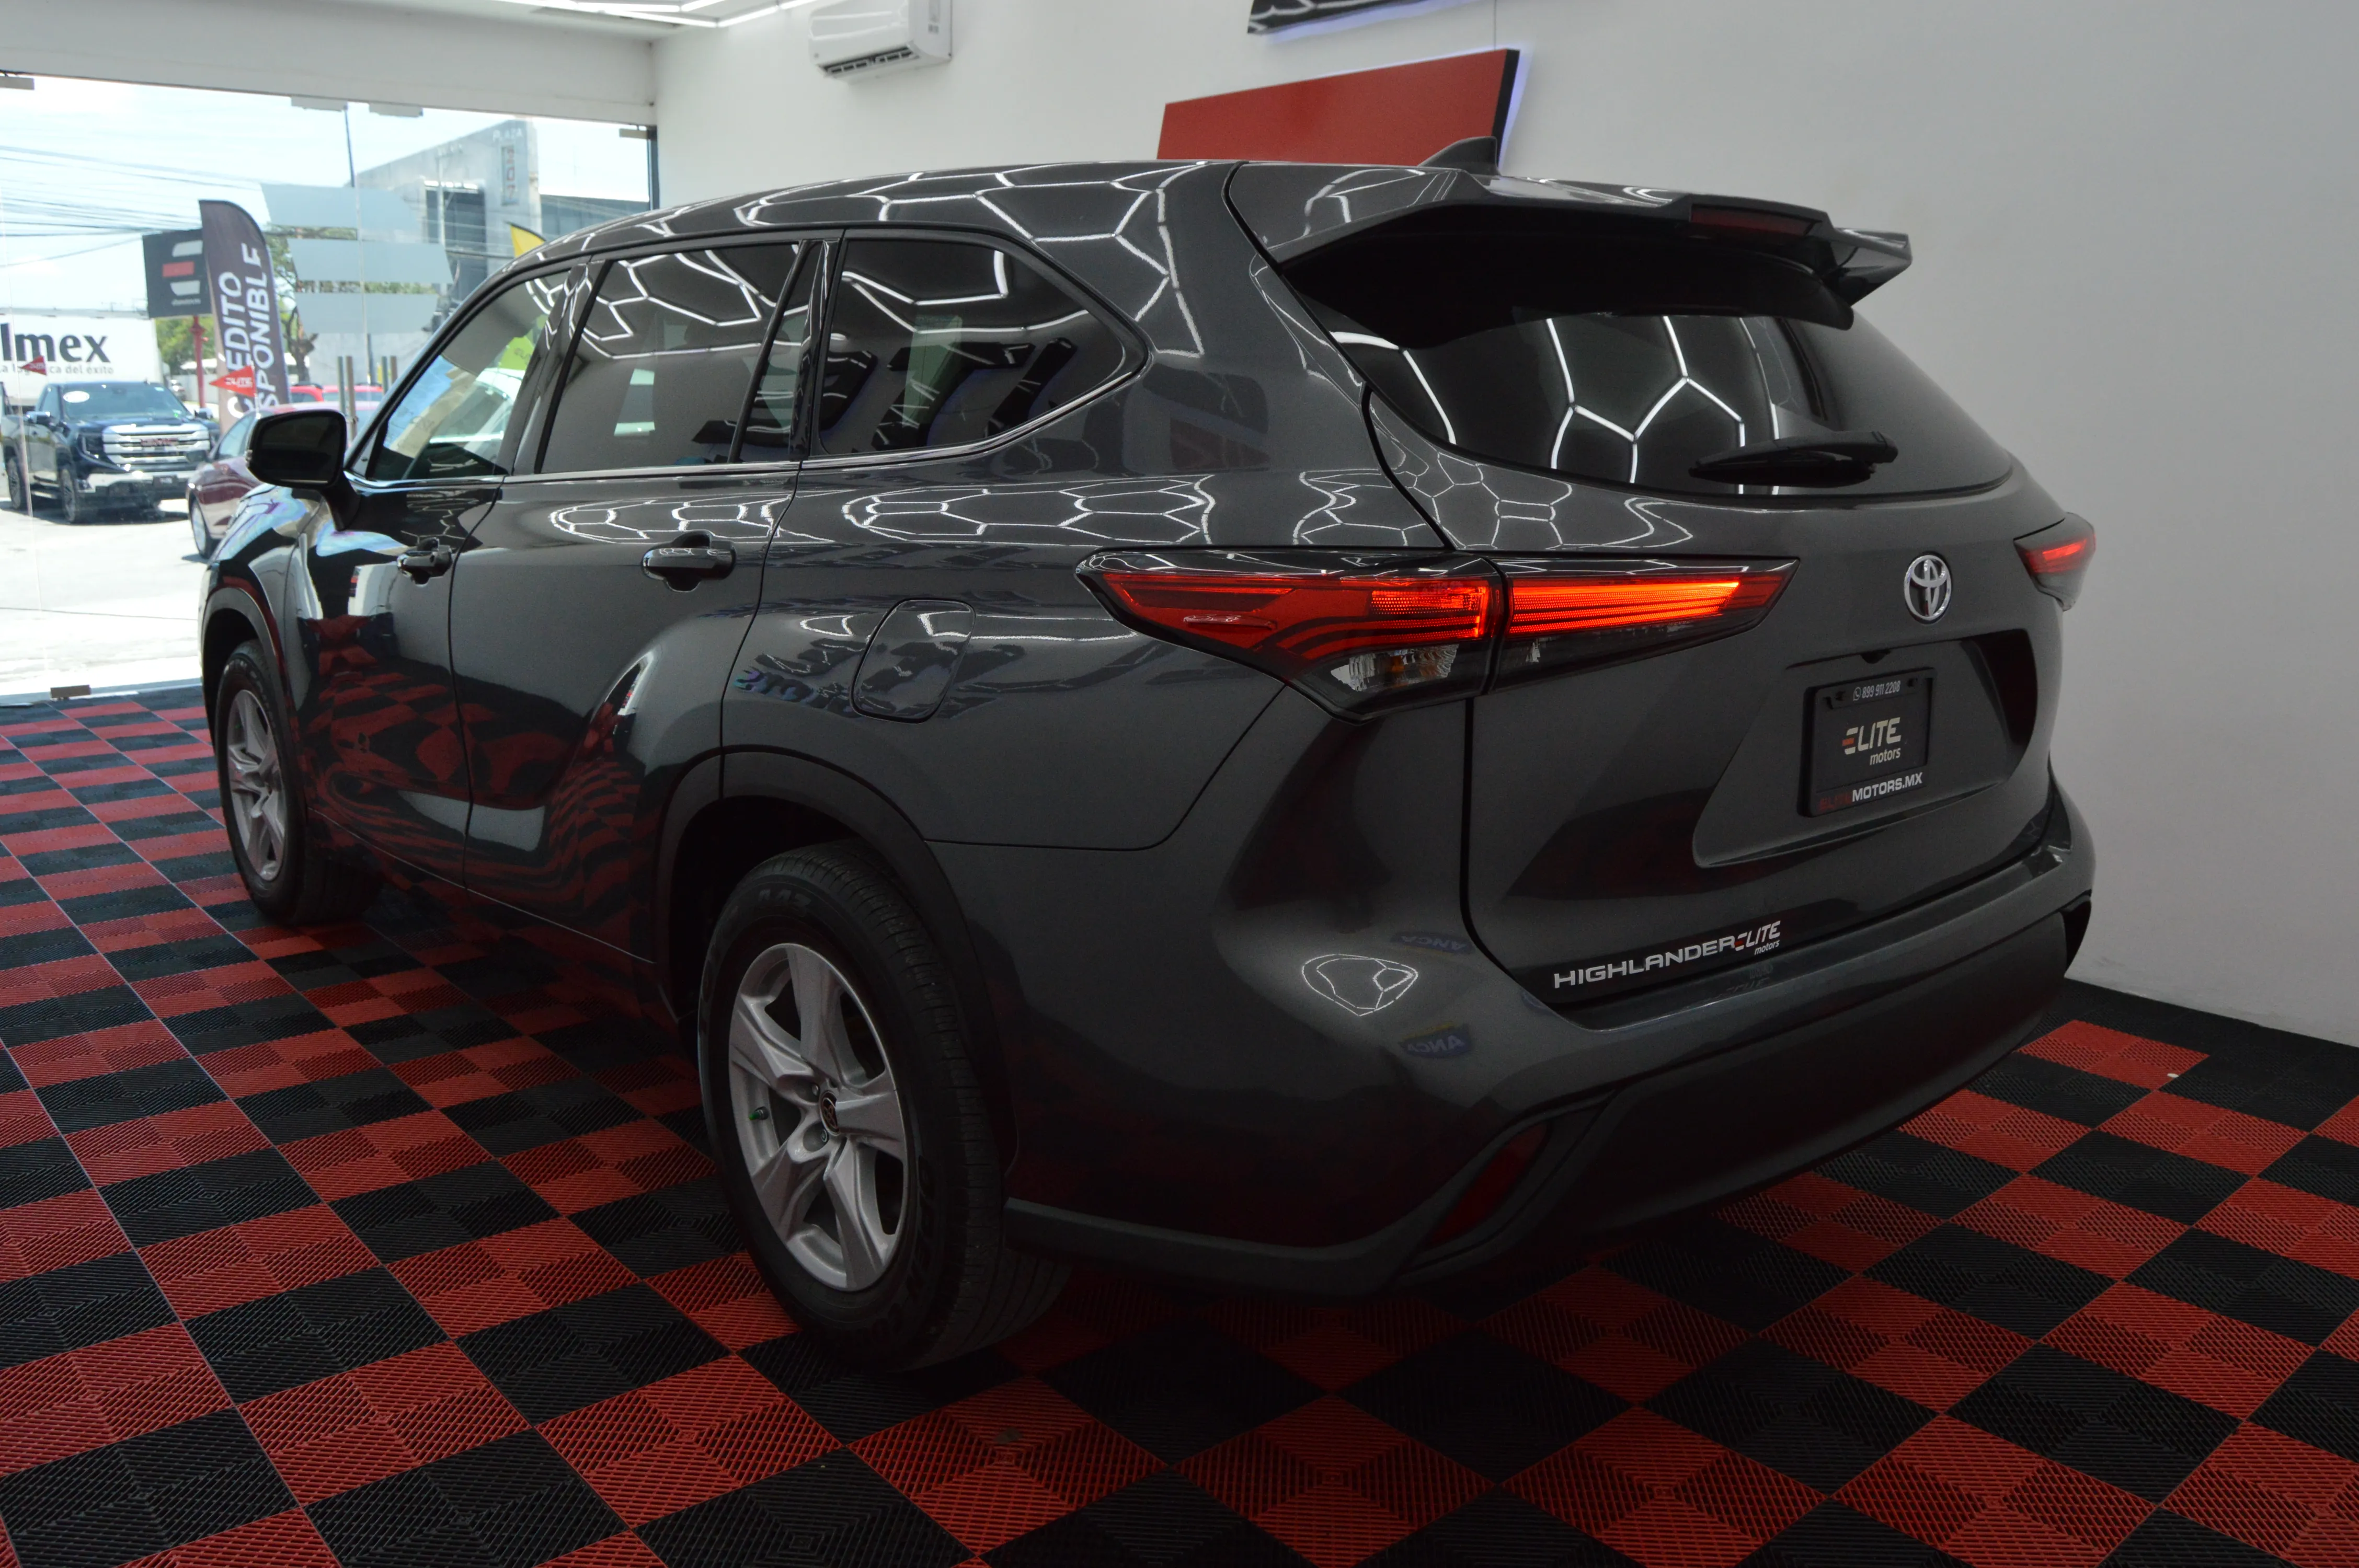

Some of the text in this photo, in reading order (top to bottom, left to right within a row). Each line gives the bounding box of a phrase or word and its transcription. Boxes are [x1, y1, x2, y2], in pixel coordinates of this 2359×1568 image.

[218, 271, 255, 418] CÉDITO
[1862, 681, 1901, 699] 899 911 2208
[1842, 717, 1902, 755] ELITE
[1870, 747, 1902, 766] motors
[1734, 920, 1781, 951] ELITE
[1755, 940, 1780, 955] motors
[1554, 935, 1735, 988] HIGHLANDER
